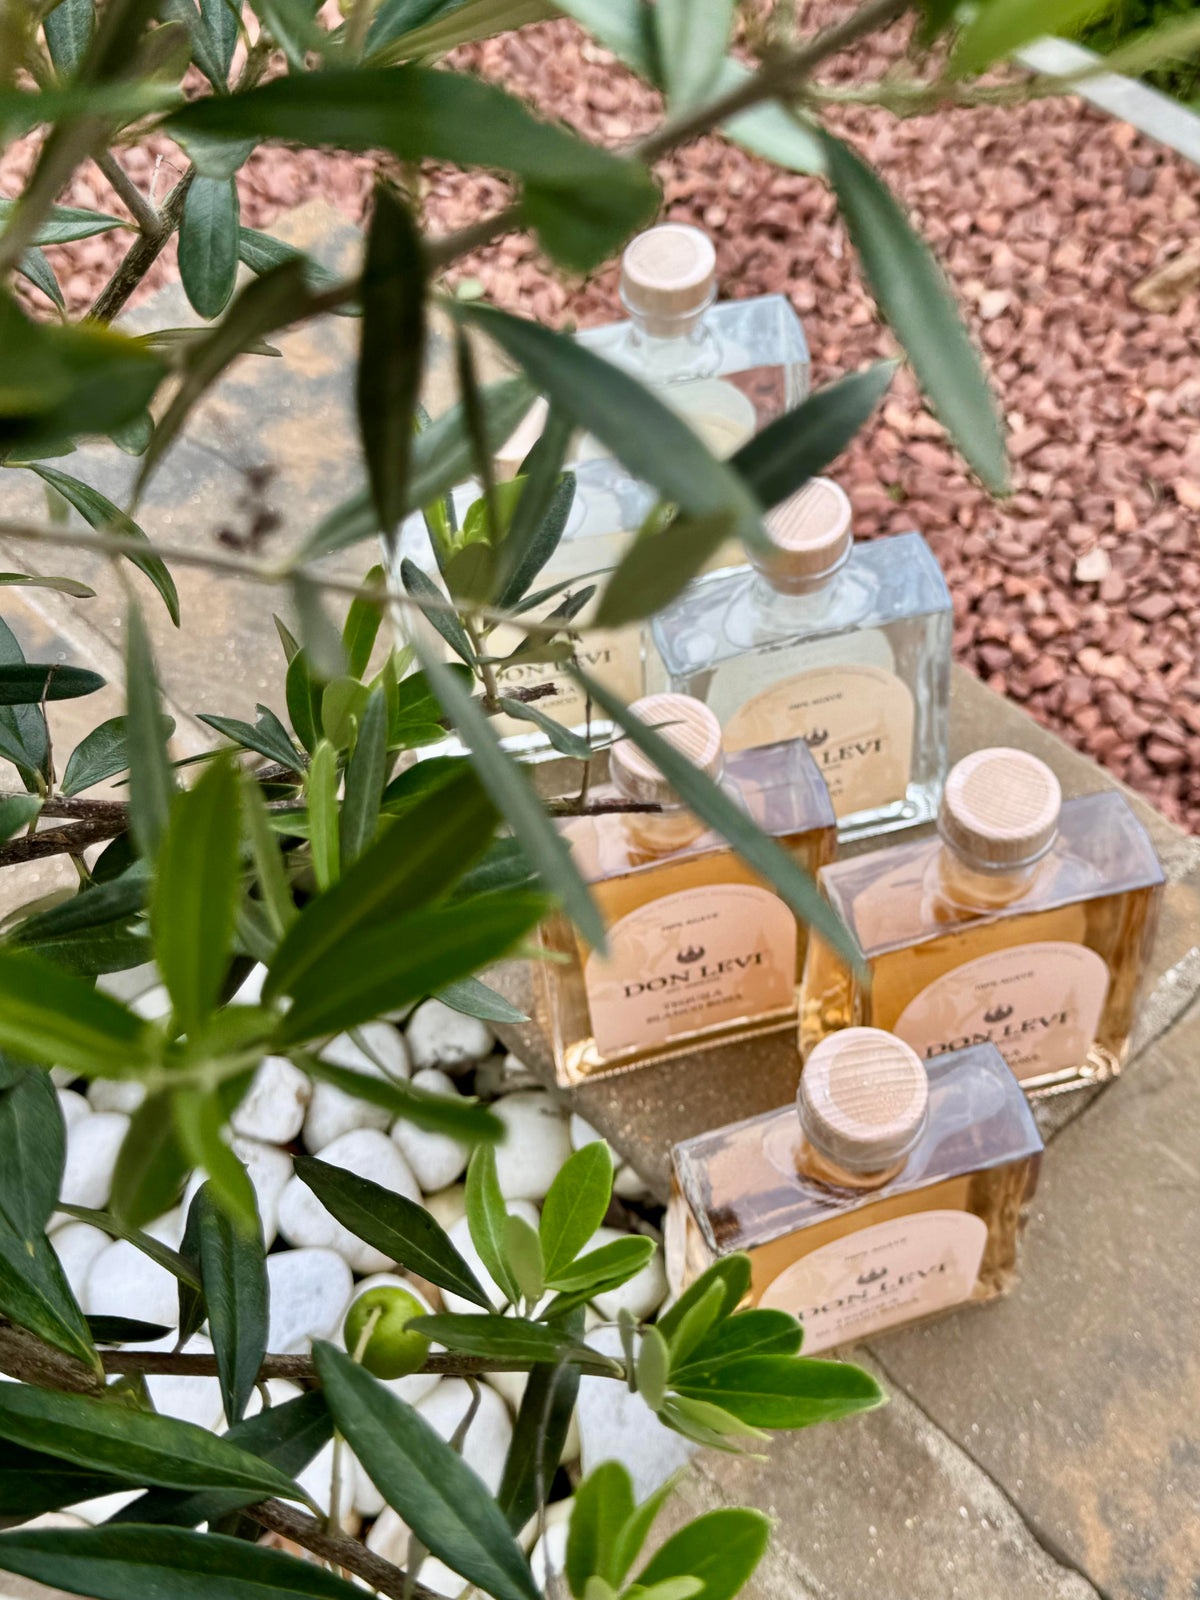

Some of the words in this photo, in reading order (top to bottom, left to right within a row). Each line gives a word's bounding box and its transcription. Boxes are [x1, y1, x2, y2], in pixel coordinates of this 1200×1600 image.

[822, 737, 883, 765] LEVI
[624, 969, 691, 998] DON
[700, 952, 764, 979] LEVI
[1003, 1011, 1068, 1037] LEVI
[798, 1289, 868, 1321] DON
[880, 1263, 946, 1291] LEVI
